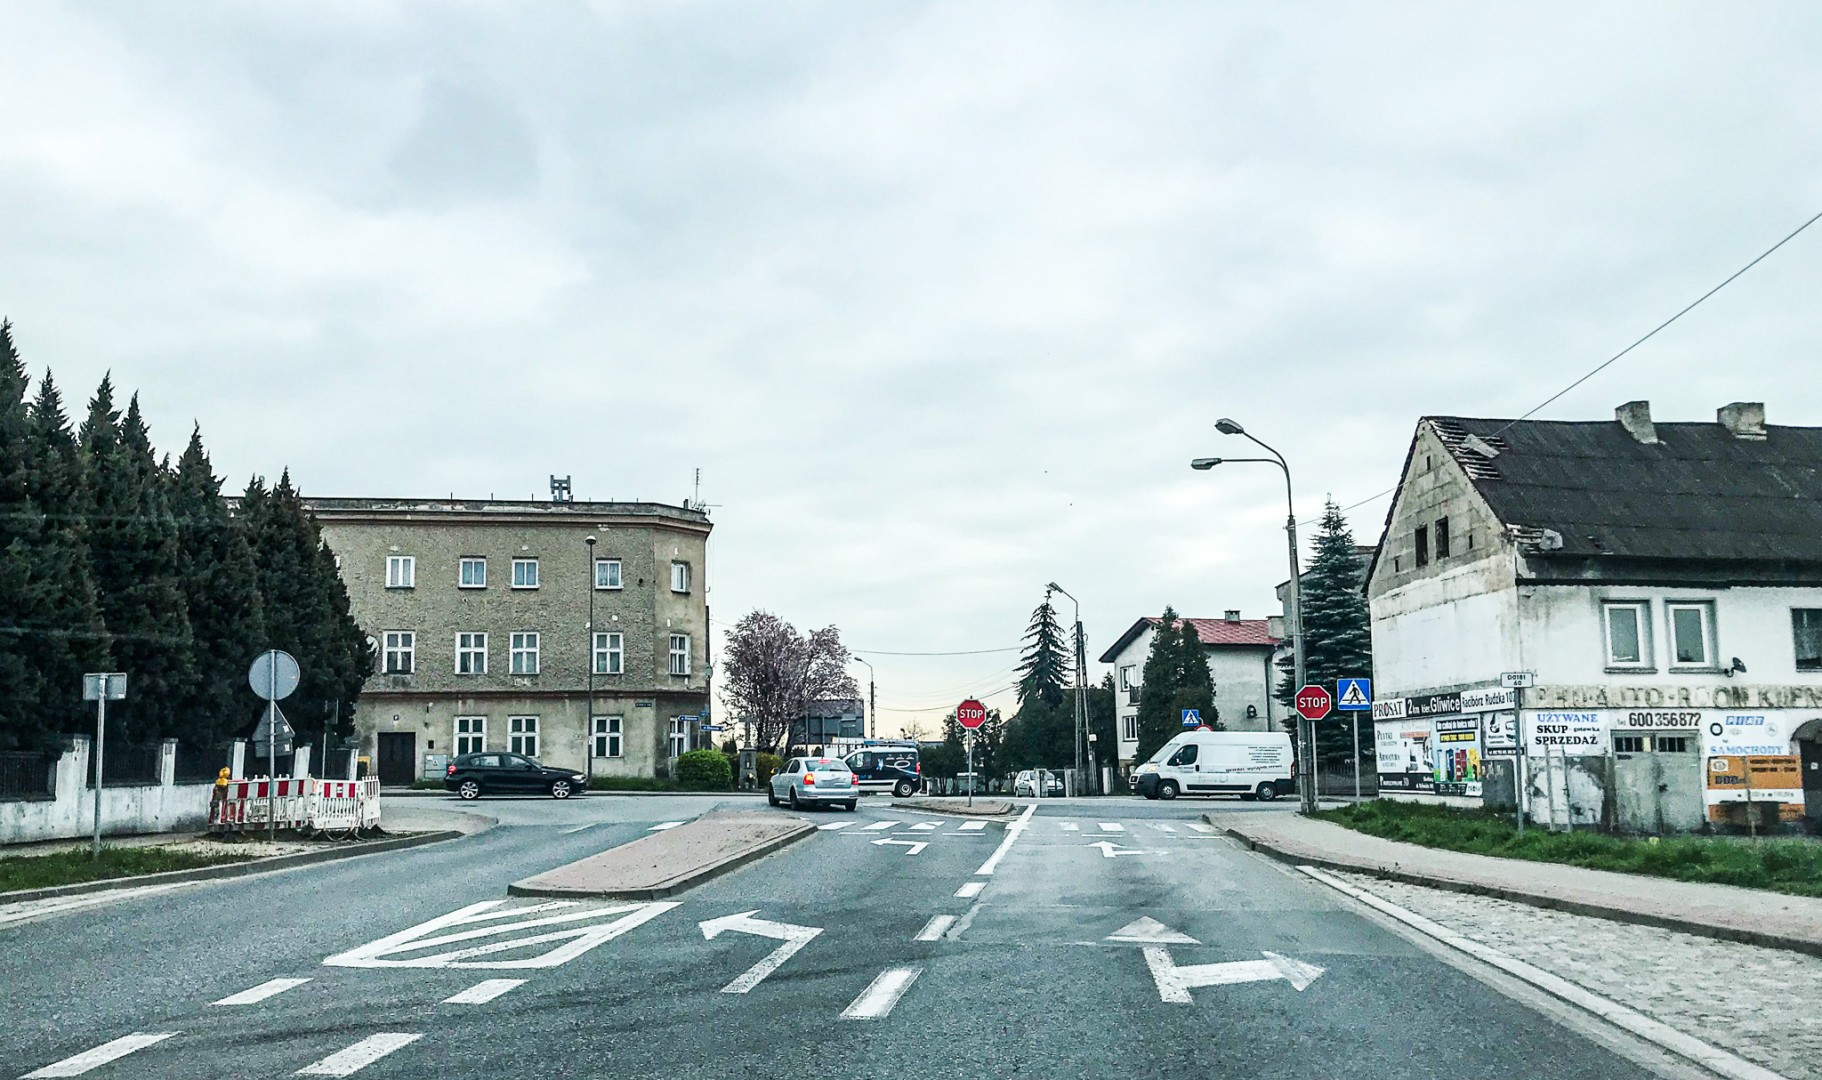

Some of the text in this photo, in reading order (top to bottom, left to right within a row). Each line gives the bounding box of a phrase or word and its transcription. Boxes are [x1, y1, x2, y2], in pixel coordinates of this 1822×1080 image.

[1299, 697, 1328, 709] STOP
[1407, 698, 1413, 715] 2
[1430, 696, 1461, 713] Gliwice
[1461, 694, 1484, 708] Racibórz
[1485, 692, 1505, 705] Rudzka
[959, 708, 984, 719] STOP
[1373, 701, 1403, 717] PROSAT
[1536, 712, 1598, 723] UŻYWANE
[1536, 725, 1569, 734] SKUP
[1535, 734, 1599, 745] SPRZEDAŻ
[1709, 745, 1784, 755] SAMOCHODY
